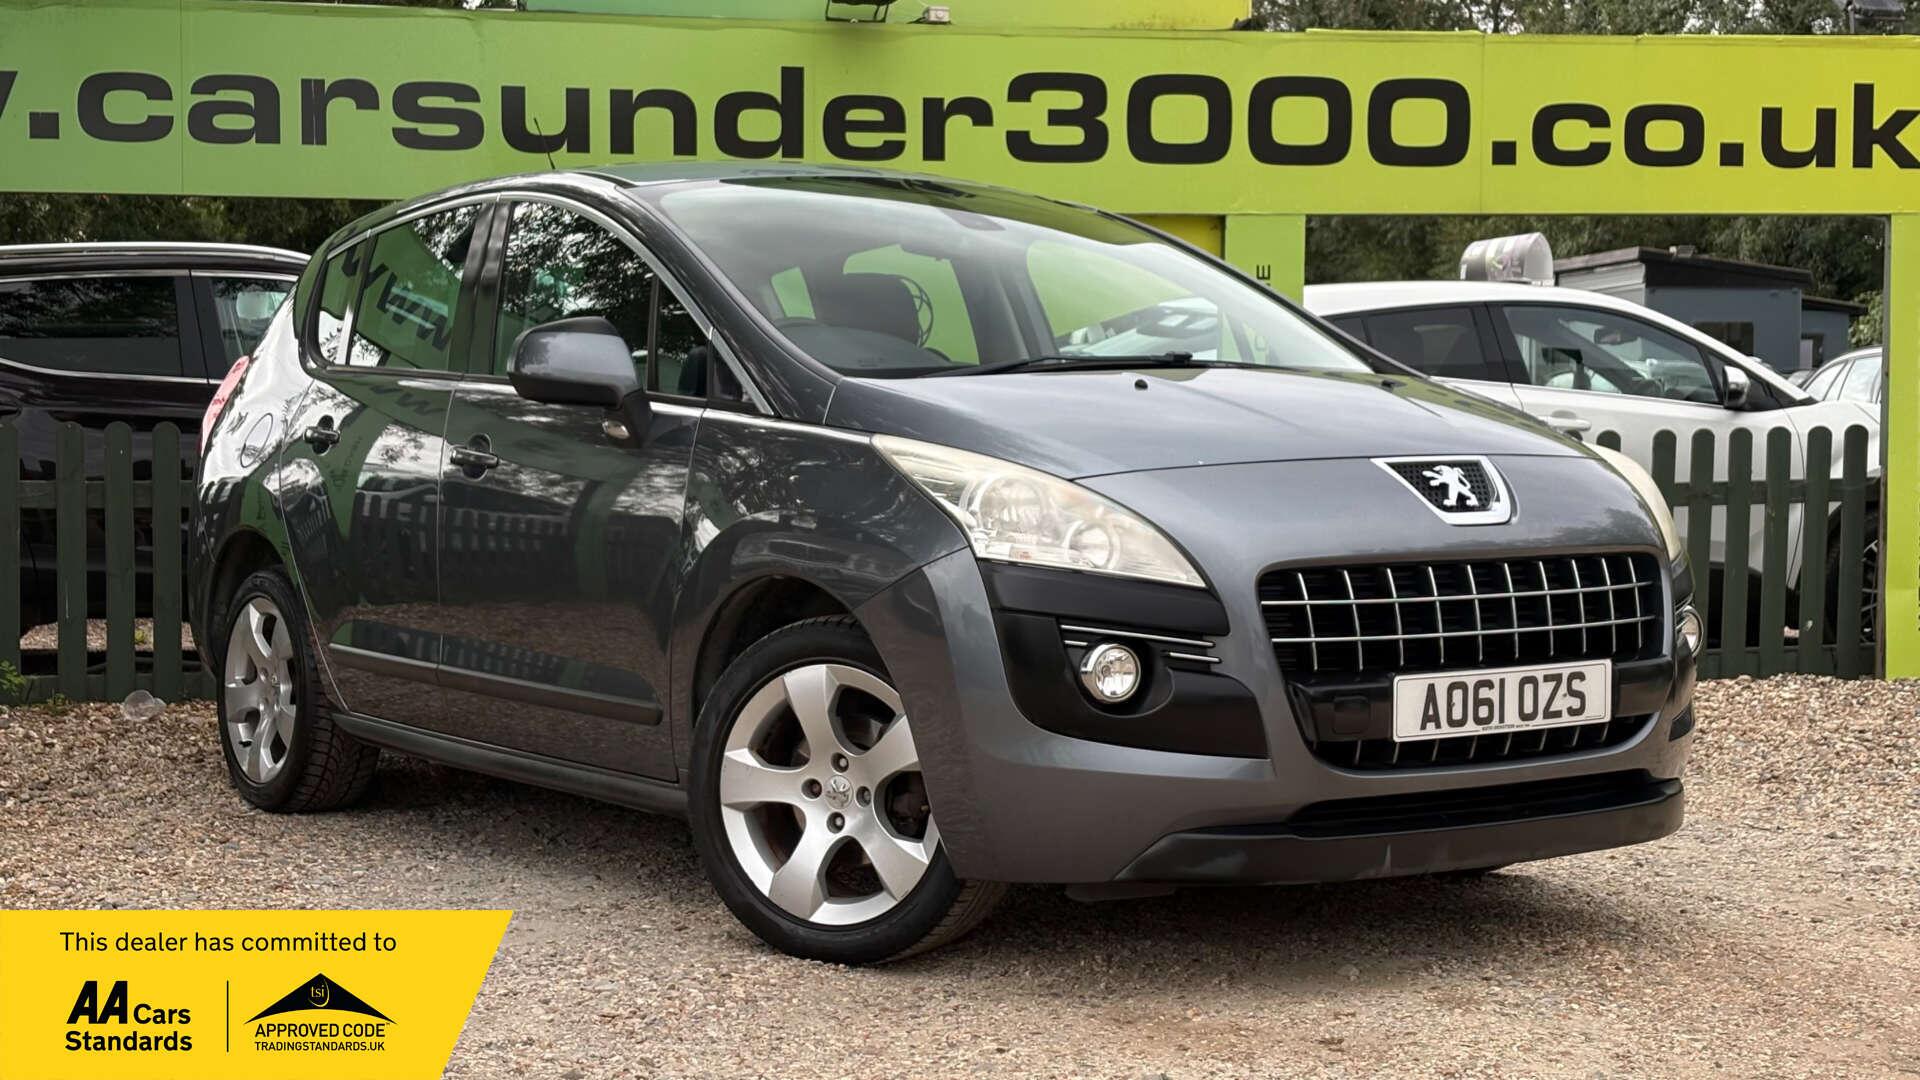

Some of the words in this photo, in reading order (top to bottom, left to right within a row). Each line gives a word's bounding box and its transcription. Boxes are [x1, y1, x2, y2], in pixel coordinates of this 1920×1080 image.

[0, 65, 1920, 169] .carsunder3000.co.uk
[1419, 677, 1506, 731] AO61
[1518, 671, 1587, 722] OZS
